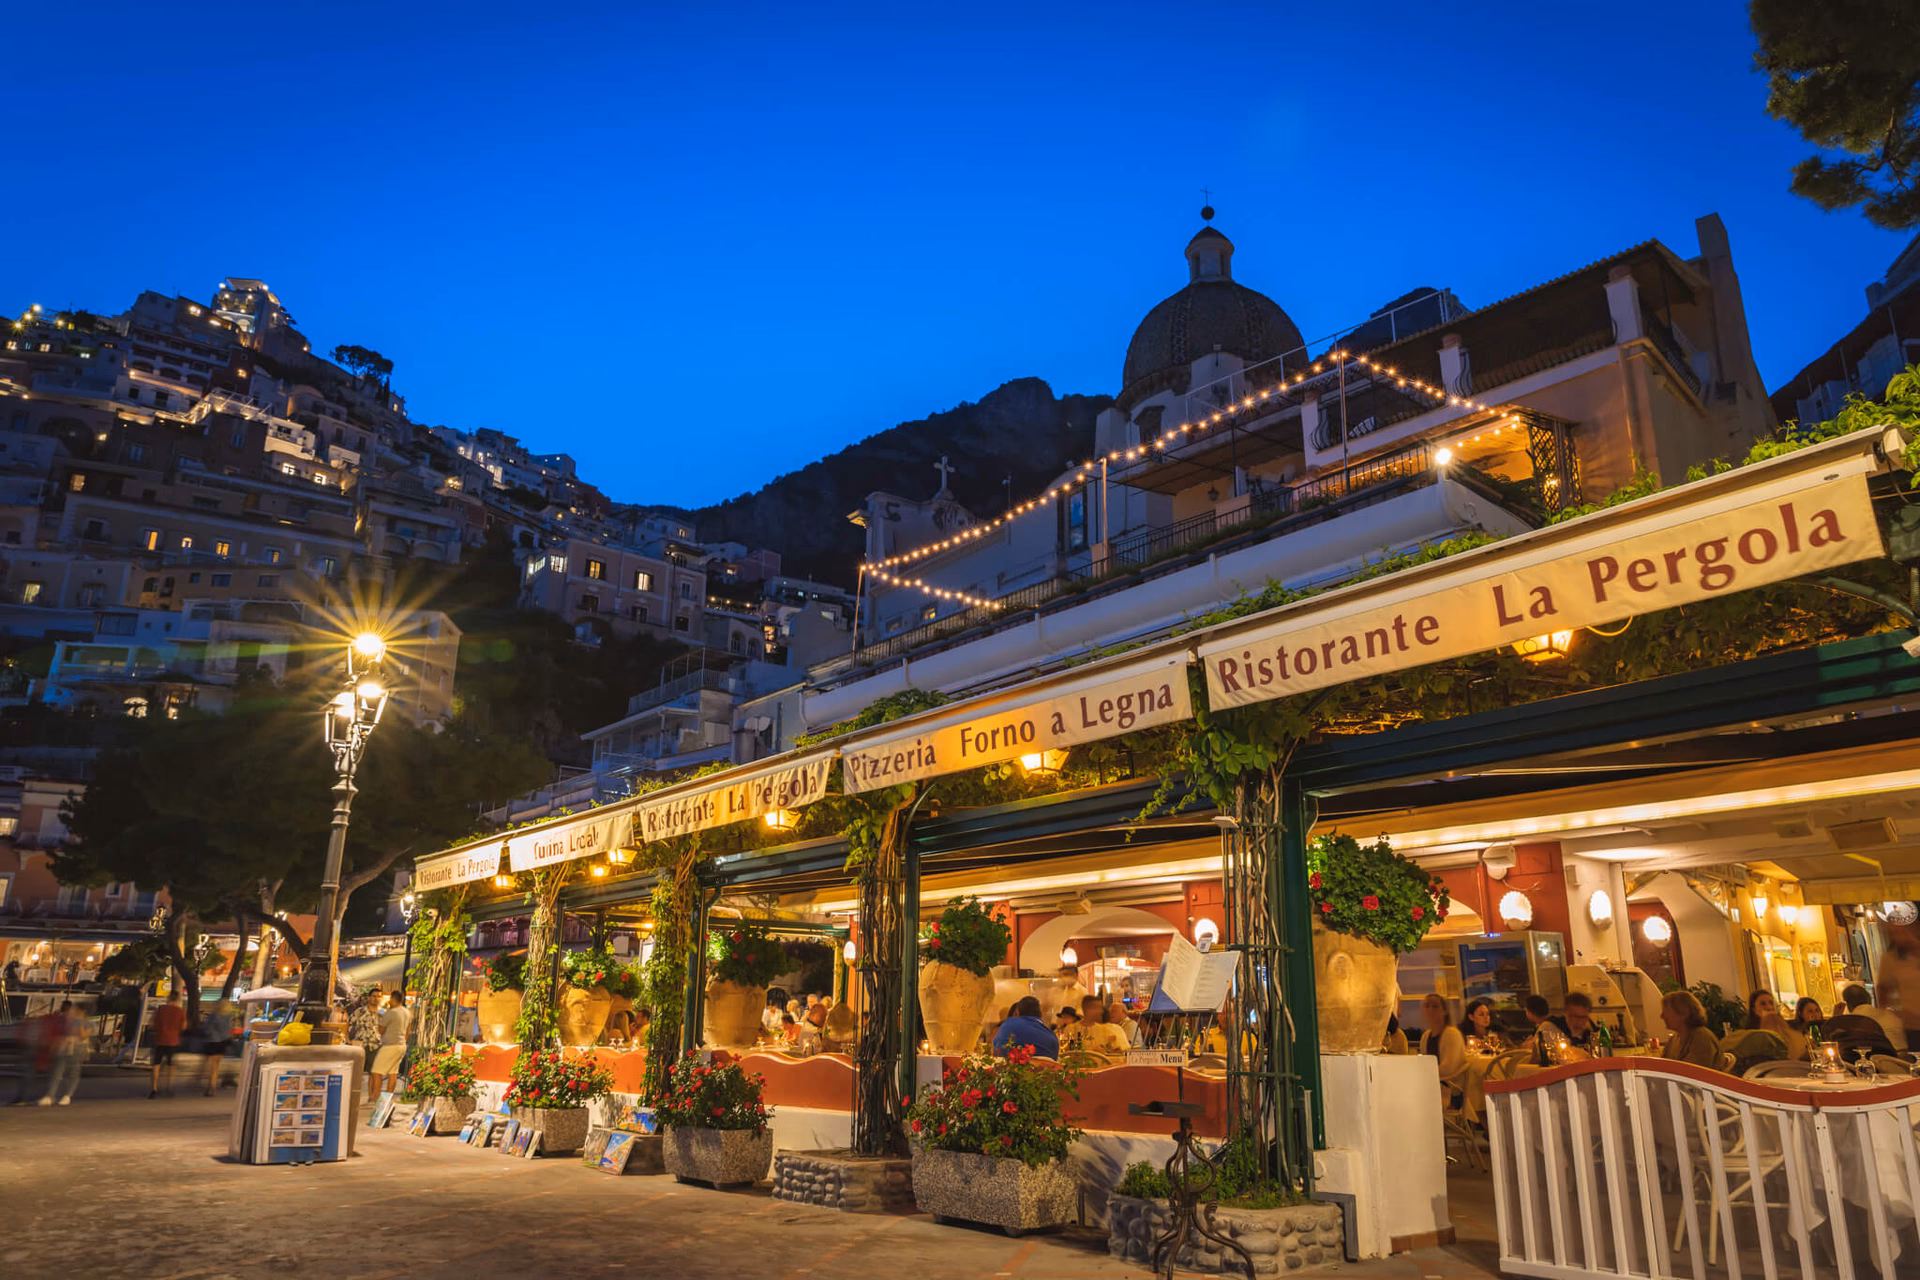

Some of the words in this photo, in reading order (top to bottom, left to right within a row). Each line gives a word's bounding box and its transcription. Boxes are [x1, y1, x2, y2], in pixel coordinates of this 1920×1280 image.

[1218, 612, 1441, 694] Ristorante
[1492, 584, 1558, 627] La
[1587, 502, 1846, 602] Pergola
[850, 739, 936, 783] Pizzeria
[960, 719, 1036, 758] Forno
[1050, 711, 1066, 736] a
[1080, 682, 1175, 730] Legna
[648, 799, 715, 832] Ristorante
[728, 790, 746, 814] La
[457, 861, 466, 878] La
[1160, 1053, 1182, 1063] Menu
